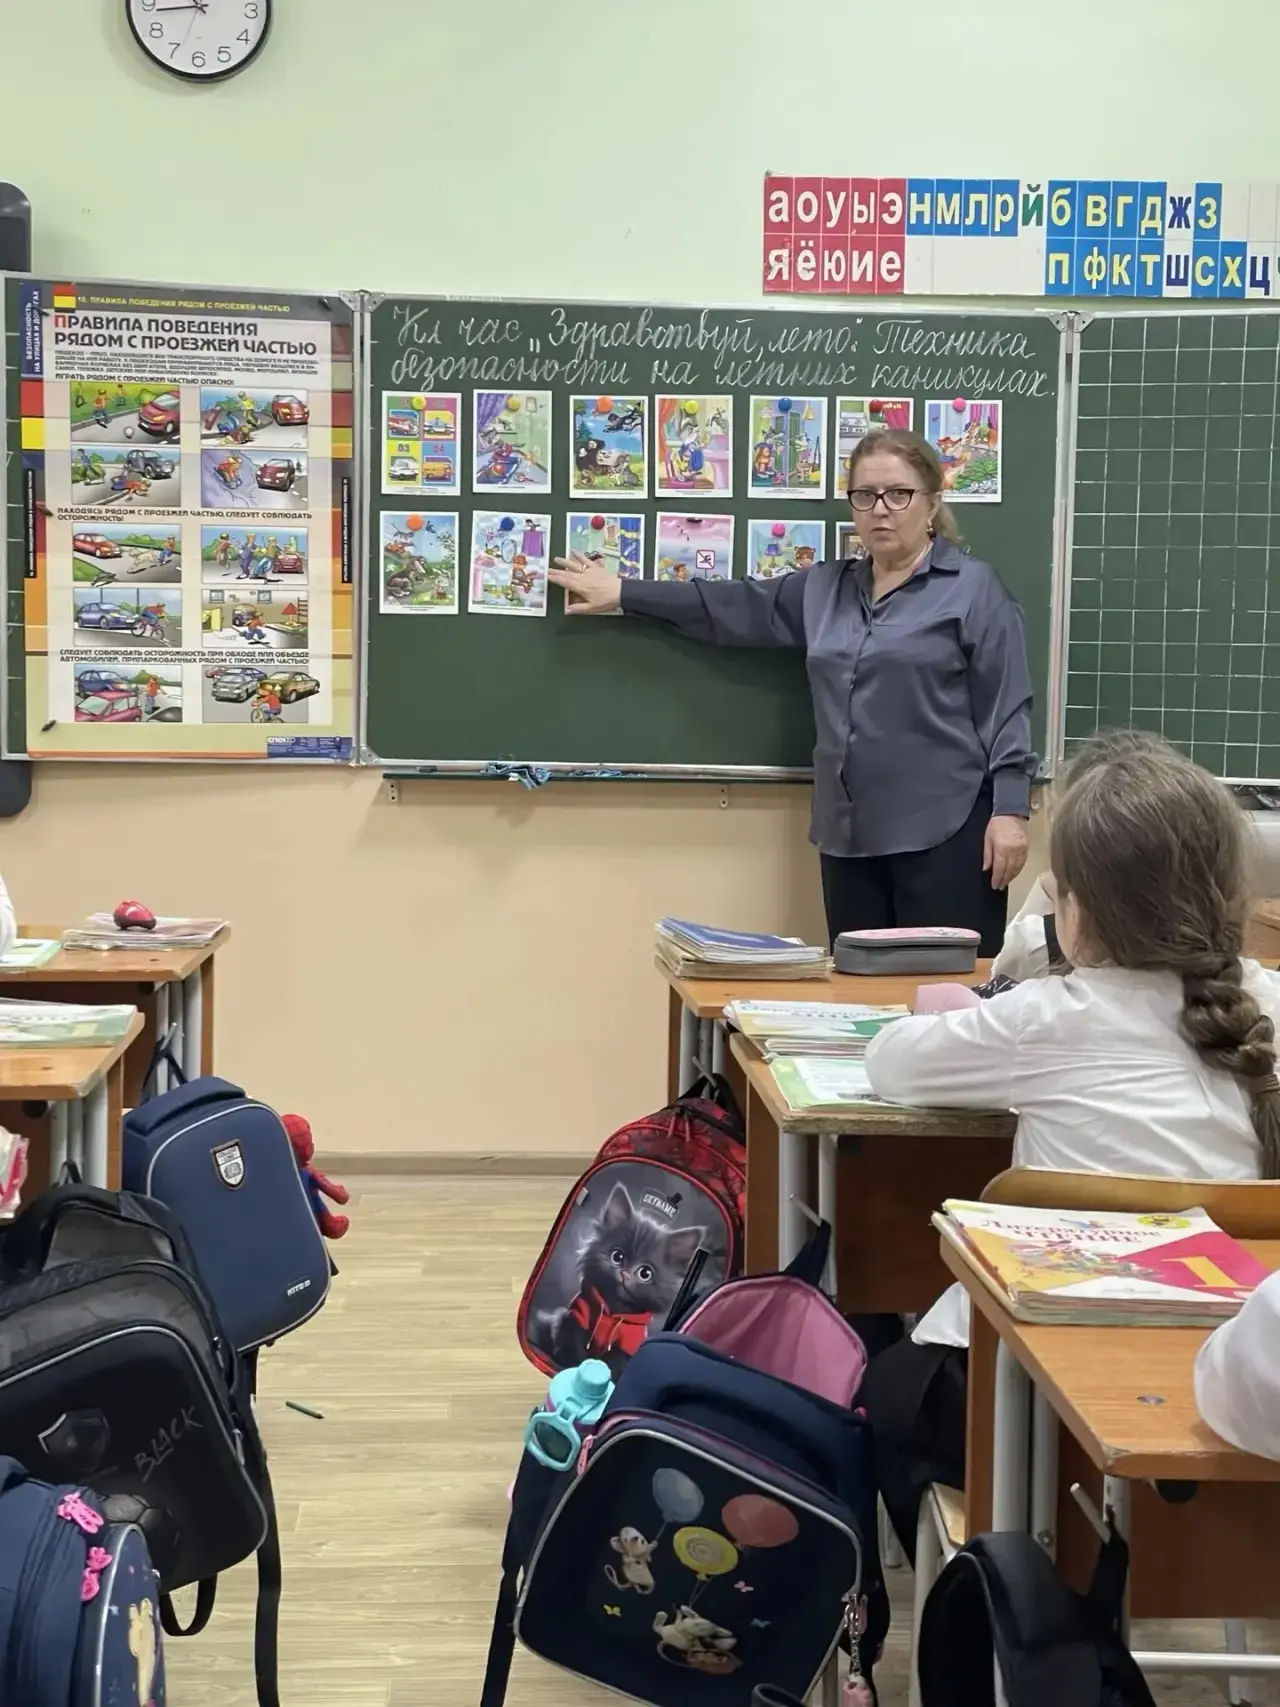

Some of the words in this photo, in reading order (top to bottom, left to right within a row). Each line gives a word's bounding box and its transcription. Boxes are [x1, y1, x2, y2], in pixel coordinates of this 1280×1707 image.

[142, 0, 156, 12] 9
[244, 2, 259, 19] 3
[149, 22, 164, 39] 8
[236, 28, 251, 45] 4
[168, 42, 181, 59] 7
[217, 46, 232, 63] 5
[191, 51, 206, 68] 6
[90, 296, 127, 305] ПРАВИЛА
[128, 298, 176, 307] ПОВЕДЕНИЯ
[178, 300, 205, 309] РЯДОМ
[214, 301, 256, 311] ПРОЕЗЖЕЙ
[258, 304, 291, 313] ЧАСТЬЮ
[54, 313, 145, 333] ПРАВИЛА
[147, 316, 258, 336] ПОВЕДЕНИЯ
[54, 333, 124, 350] РЯДОМ
[127, 336, 138, 350] С
[140, 336, 240, 355] ПРОЕЗЖЕЙ
[242, 339, 317, 356] ЧАСТЬЮ
[458, 316, 523, 346] час
[873, 319, 1037, 357] Техника
[33, 332, 41, 360] УЛИЦАХ
[391, 347, 631, 392] безопасности
[650, 359, 701, 386] на
[715, 357, 858, 388] летних
[167, 377, 199, 385] ЧАСТЬЮ
[57, 507, 102, 515] НАХОДЯСЬ
